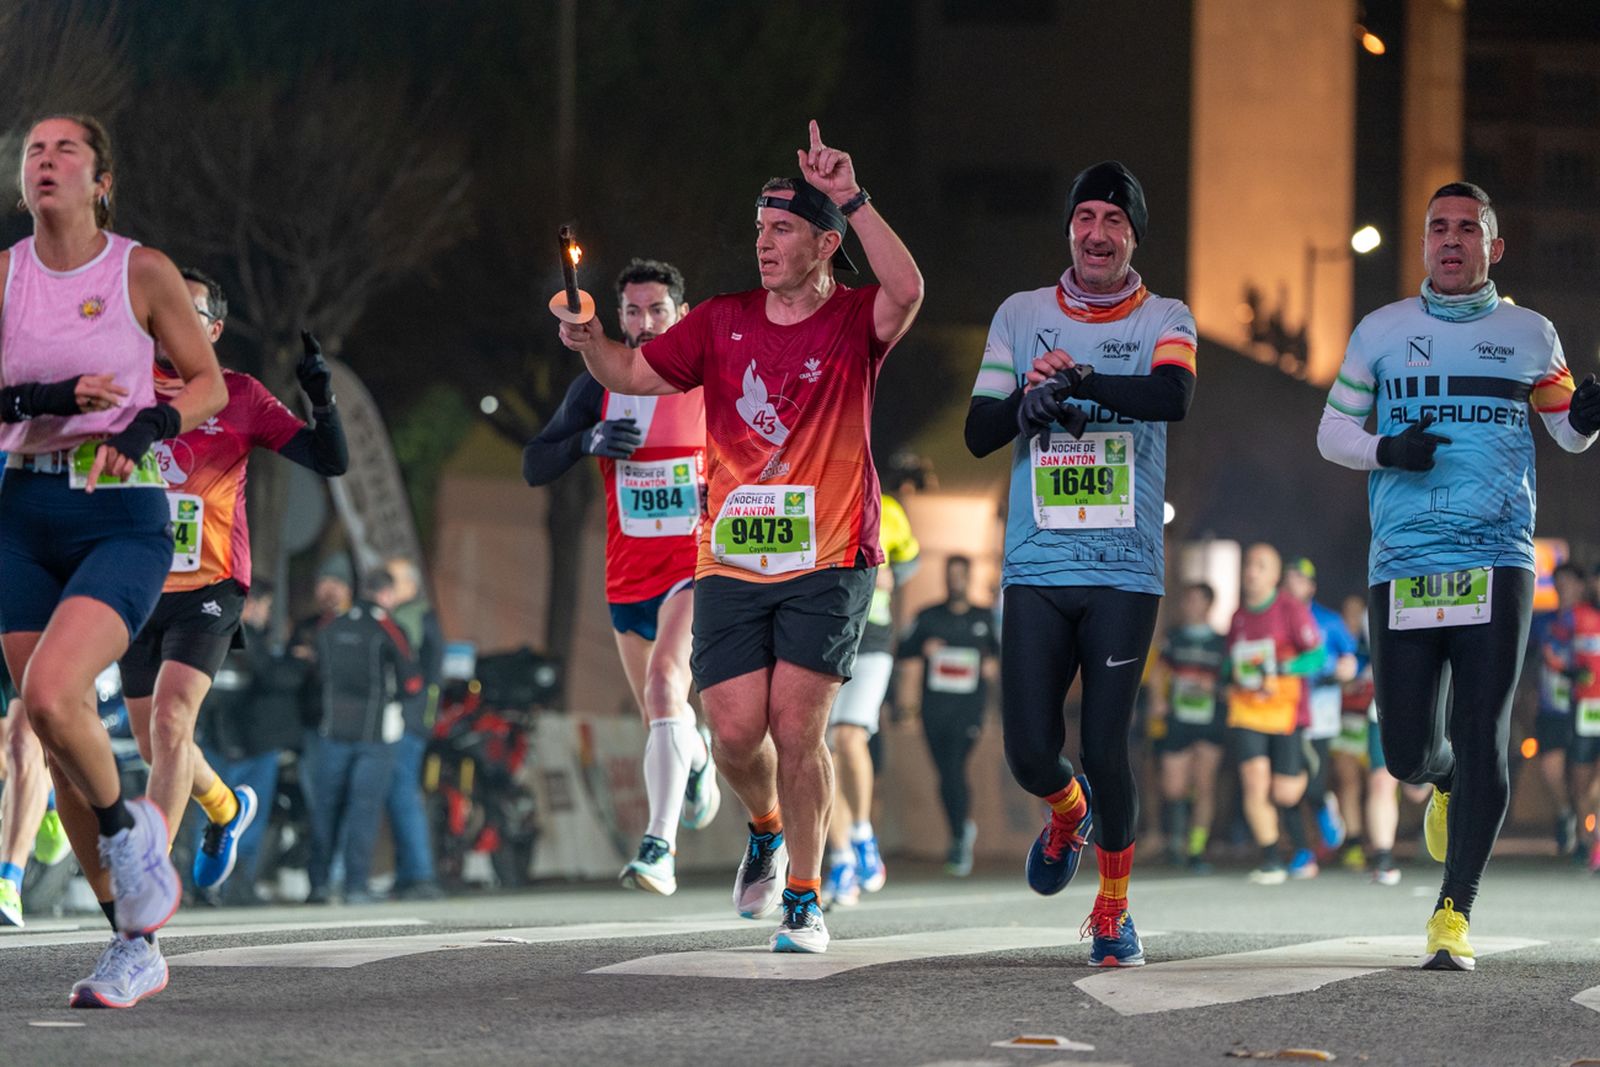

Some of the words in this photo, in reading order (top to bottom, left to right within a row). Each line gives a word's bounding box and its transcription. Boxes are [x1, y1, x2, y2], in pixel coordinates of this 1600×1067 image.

[1408, 336, 1432, 362] Ñ
[752, 410, 776, 435] 43
[1390, 404, 1526, 427] ALCAUDETE
[1040, 456, 1059, 466] SAN
[1061, 452, 1096, 465] ANTÓN
[1051, 443, 1081, 453] NOCHE
[1083, 443, 1096, 453] DE
[640, 478, 667, 488] ANTÓN
[656, 470, 665, 478] DE
[1049, 467, 1114, 496] 1649
[630, 487, 683, 511] 7984
[734, 495, 763, 504] NOCHE
[764, 495, 776, 504] DE
[726, 506, 741, 516] AN
[743, 505, 776, 516] ANTÓN
[175, 523, 189, 545] 4
[731, 518, 794, 545] 9473
[1410, 571, 1472, 598] 3018
